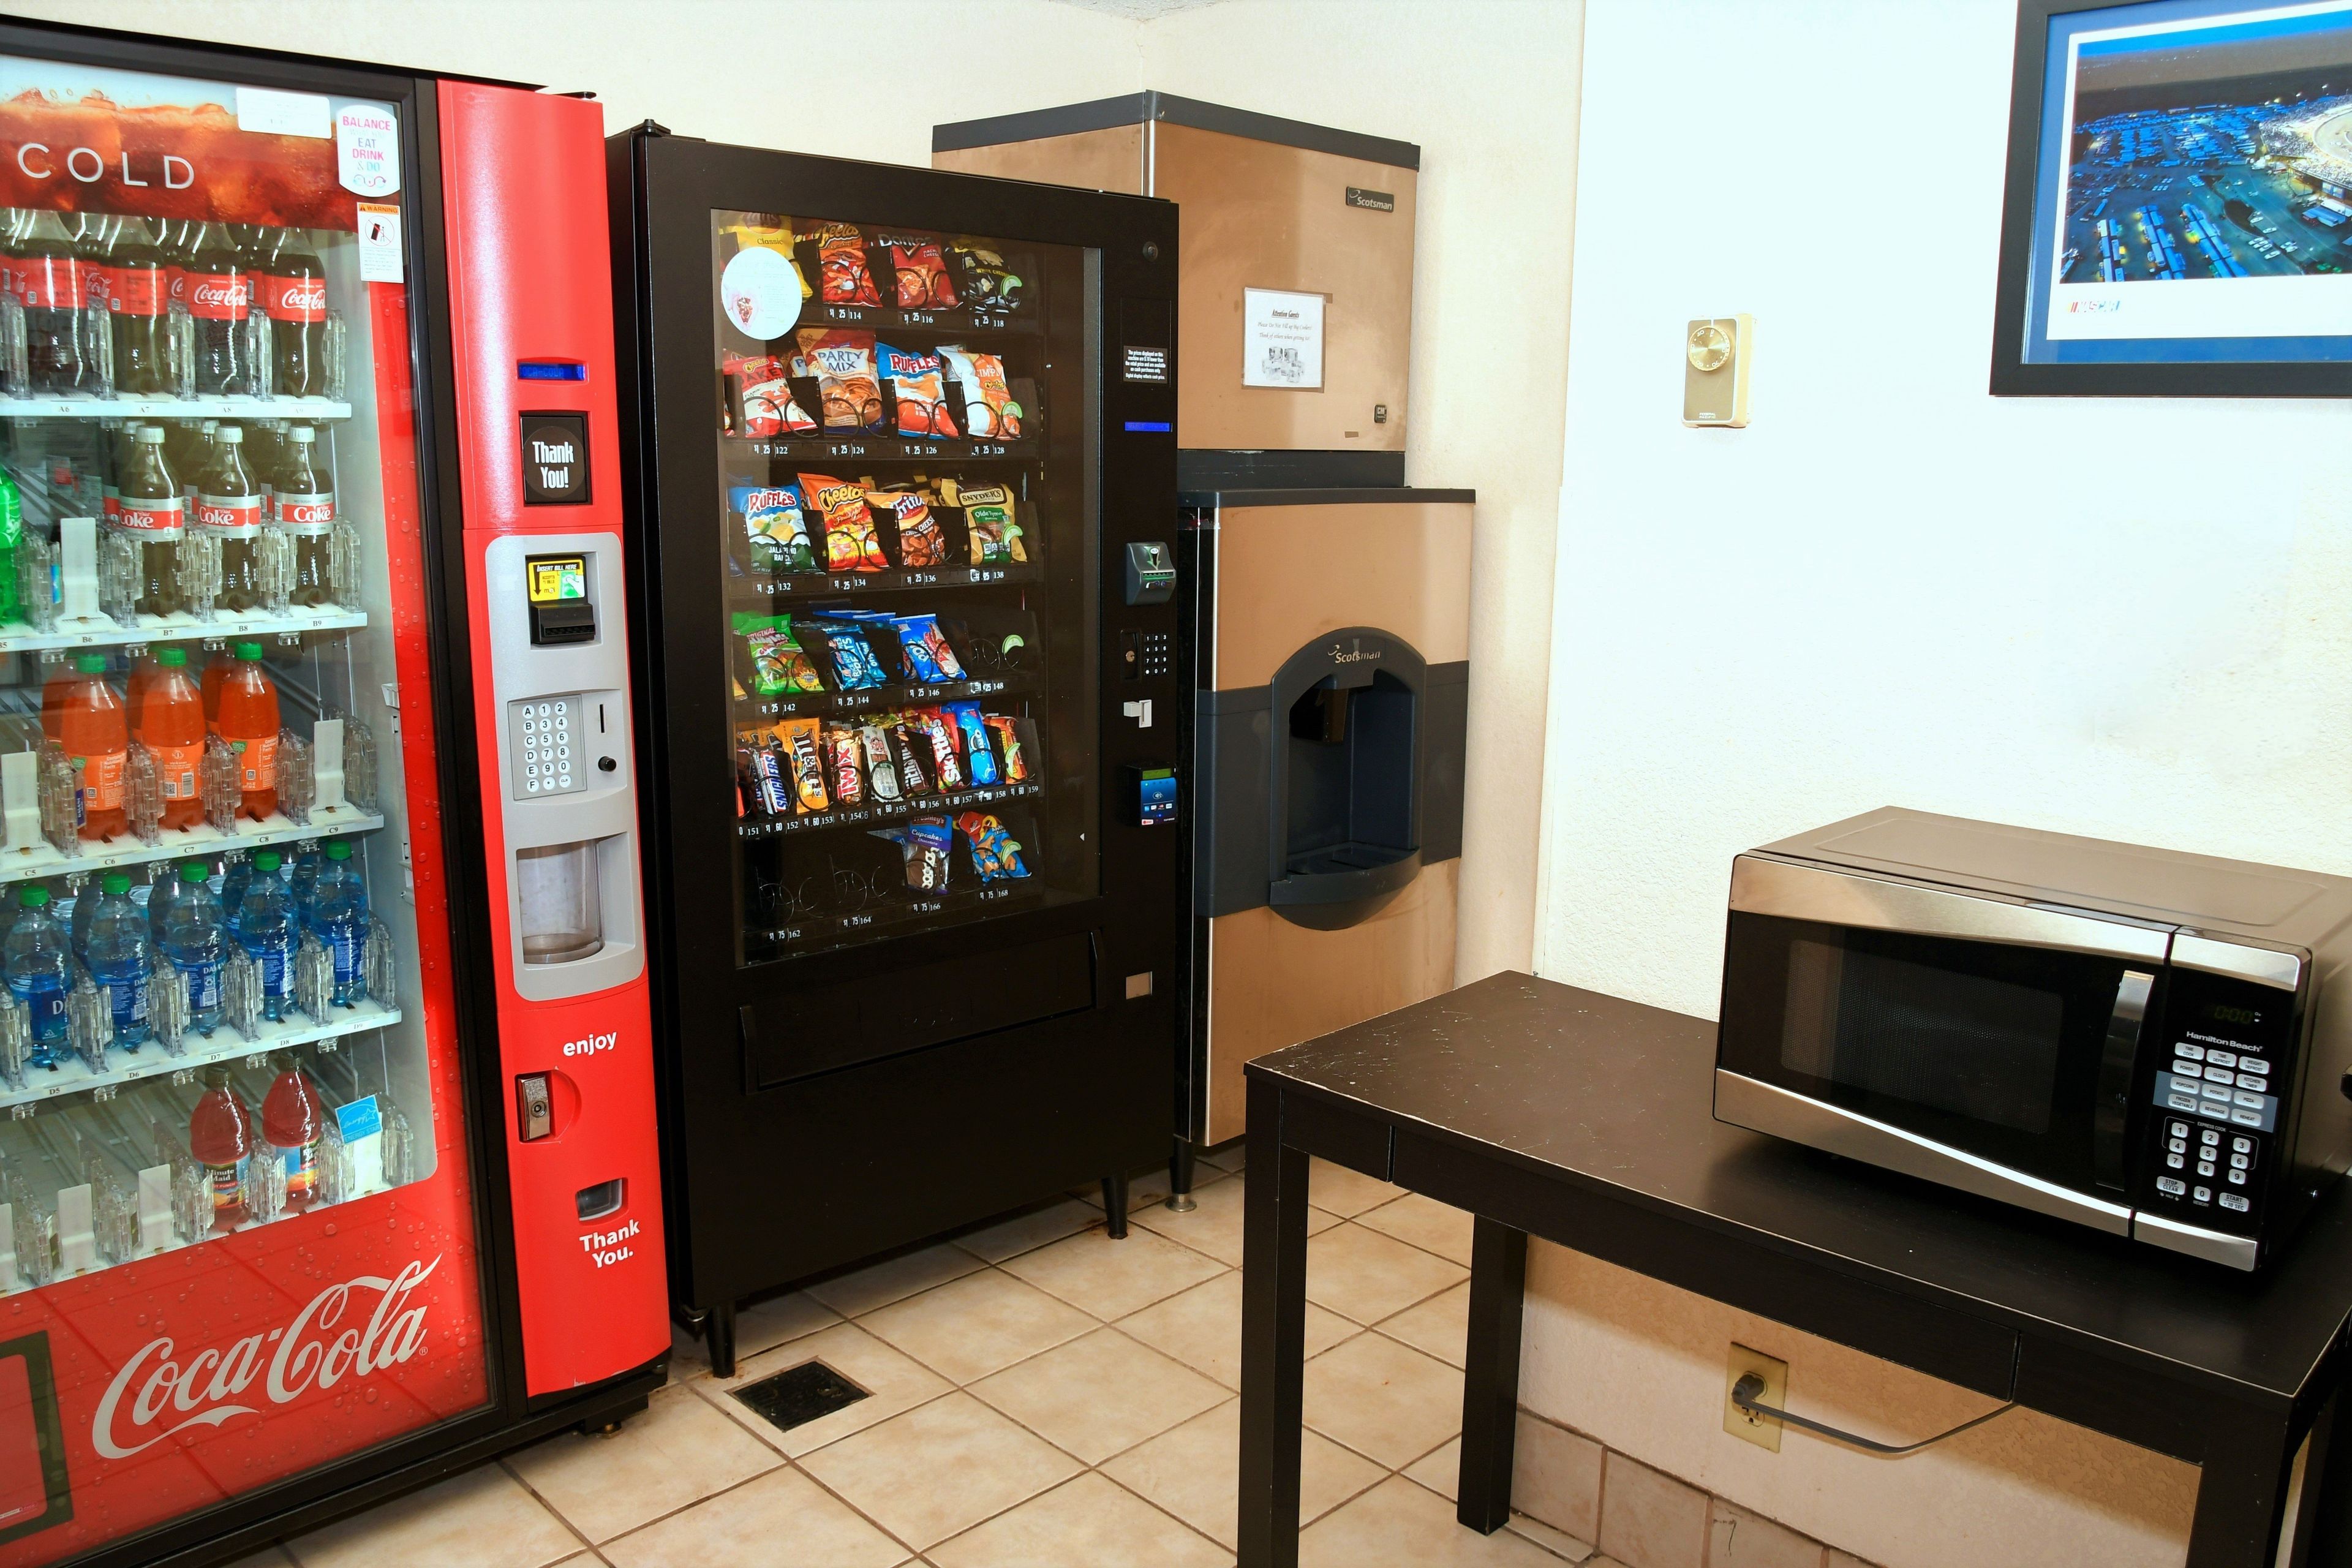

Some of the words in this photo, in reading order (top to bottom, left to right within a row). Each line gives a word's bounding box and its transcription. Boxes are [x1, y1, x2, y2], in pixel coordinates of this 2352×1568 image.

[342, 115, 391, 130] BALANCE
[358, 137, 377, 149] EAT
[352, 148, 385, 161] DRINK
[17, 141, 196, 189] COLD
[366, 161, 380, 172] DO
[366, 205, 398, 214] WARNING
[1357, 196, 1392, 211] Scotsman
[756, 237, 783, 246] Classic
[878, 233, 933, 247] Doritos
[850, 311, 862, 320] 114
[817, 350, 864, 361] PARTY
[828, 361, 857, 372] MIX
[890, 354, 941, 373] RUFFLES
[532, 441, 575, 464] Thank
[776, 446, 788, 454] 122
[853, 446, 864, 454] 124
[540, 467, 569, 489] You!
[748, 491, 797, 513] RUFFLES
[818, 484, 866, 513] Cheetos
[962, 489, 1001, 502] SNYDER'S
[119, 509, 154, 529] Coke
[199, 506, 235, 526] Coke
[293, 507, 331, 522] Coke
[1335, 650, 1381, 663] Scotsman
[783, 703, 796, 712] 142
[765, 756, 788, 812] SNICKERS
[821, 816, 833, 824] 153
[911, 829, 943, 842] Cupcakes
[789, 930, 801, 938] 162
[562, 1030, 617, 1057] enjoy
[2186, 1031, 2229, 1046] Hamilton
[2229, 1040, 2261, 1053] Beach
[2176, 1081, 2195, 1090] POPCORN
[2171, 1100, 2194, 1109] VEGETABLE
[2204, 1106, 2225, 1115] BEVERAGE
[2197, 1121, 2215, 1129] EXPRESS
[345, 1131, 365, 1142] ENERGY
[367, 1125, 380, 1134] STAR
[2226, 1194, 2243, 1203] START
[579, 1218, 641, 1253] Thank
[592, 1245, 634, 1269] You.
[92, 1252, 443, 1459] Coca-Cola
